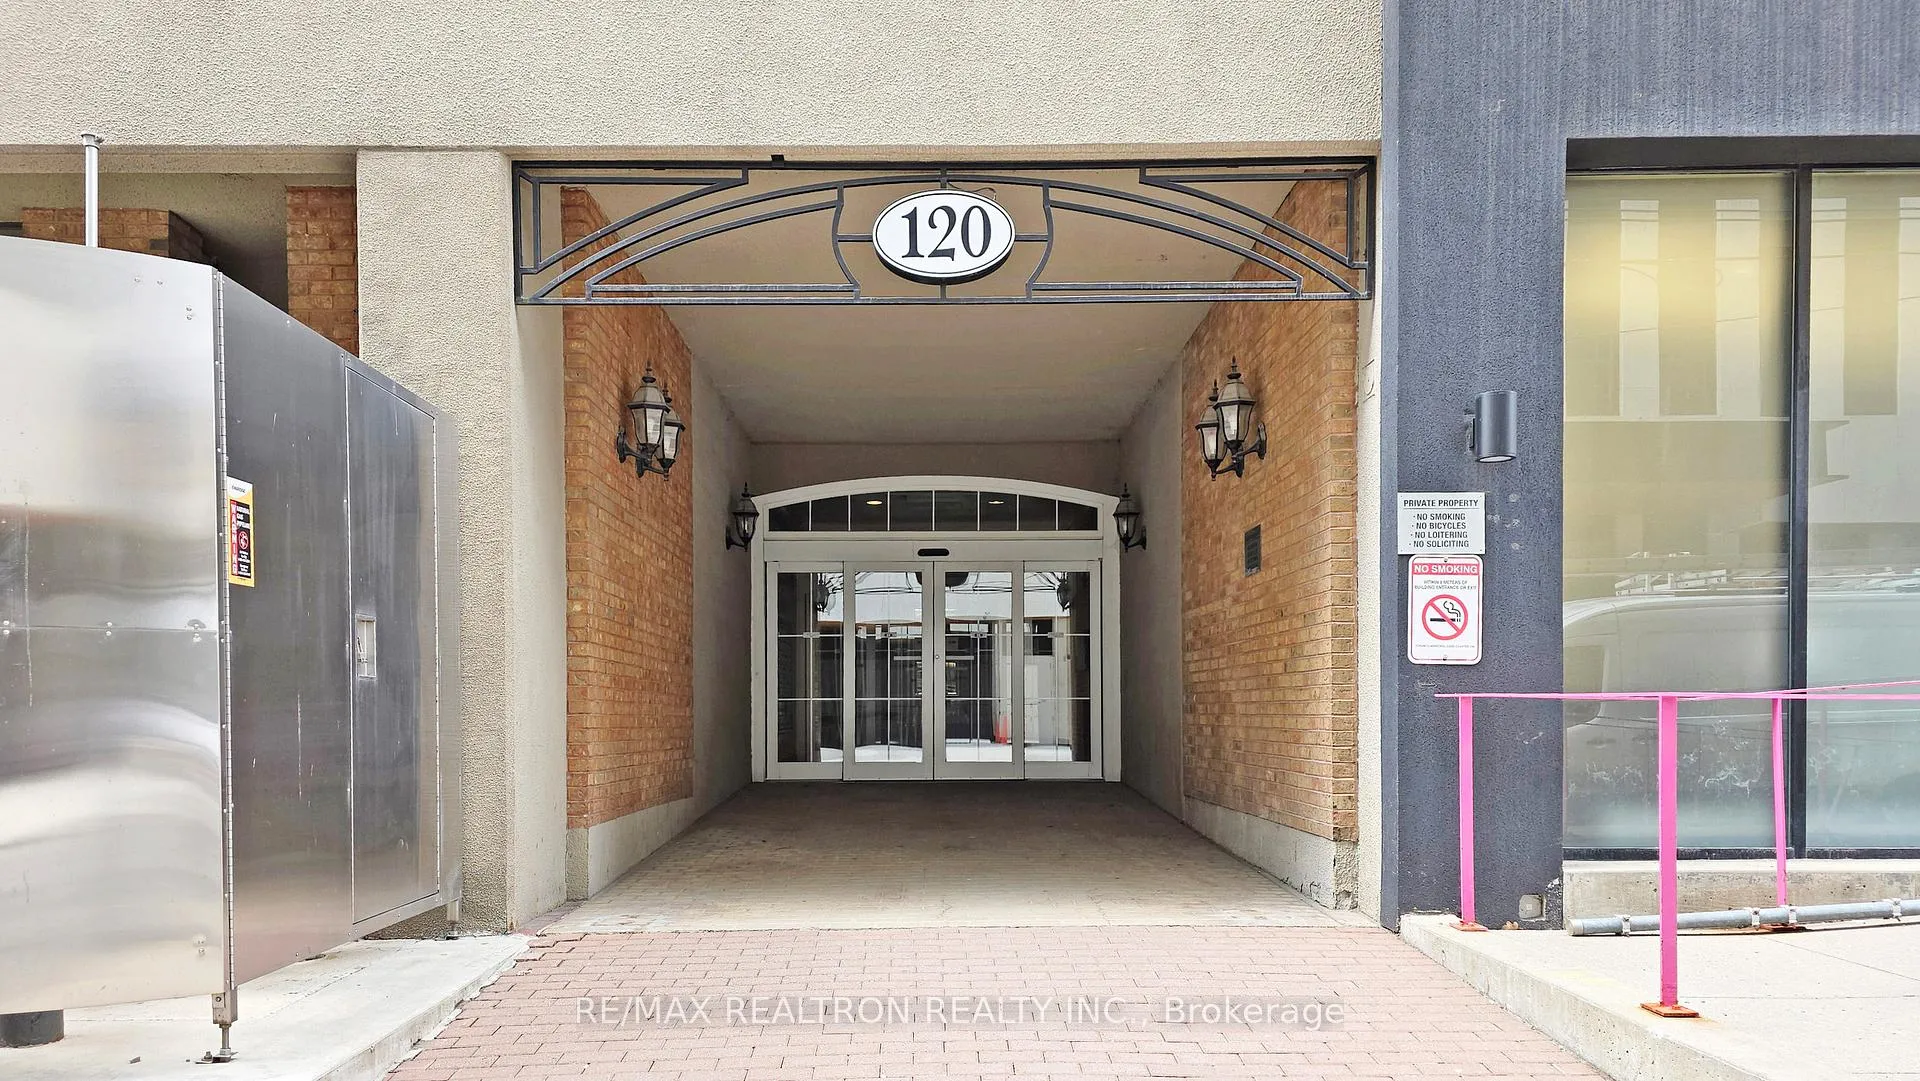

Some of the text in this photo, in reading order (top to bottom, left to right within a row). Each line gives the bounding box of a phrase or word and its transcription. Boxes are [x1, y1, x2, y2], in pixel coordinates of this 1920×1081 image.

[901, 205, 992, 261] 120
[1403, 499, 1479, 507] PRIVATE PROPERTY
[1413, 540, 1469, 548] NO SOLICITING
[1414, 565, 1477, 573] NO SMOKING
